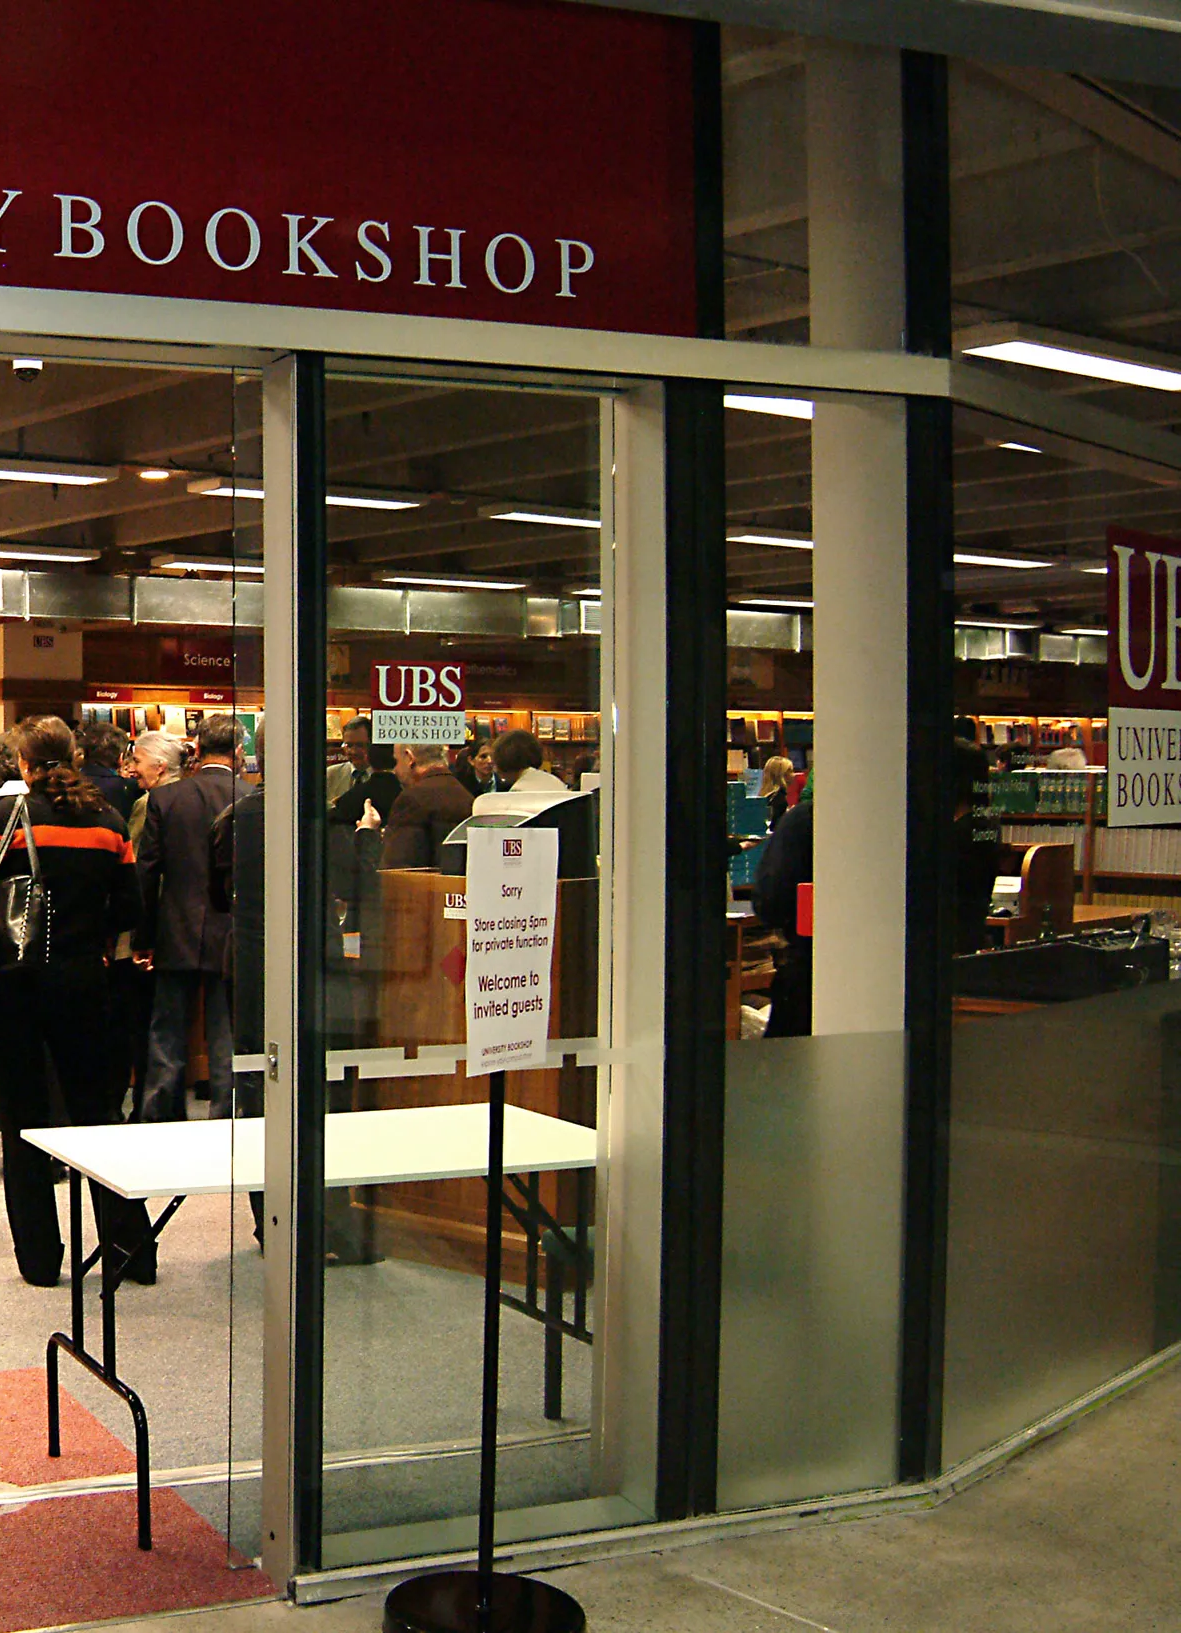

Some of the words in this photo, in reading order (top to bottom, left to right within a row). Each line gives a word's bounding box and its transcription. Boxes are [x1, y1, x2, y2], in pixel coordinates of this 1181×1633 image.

[53, 193, 596, 299] BOOKSHOP
[34, 637, 54, 648] UBS
[183, 652, 232, 668] Science
[95, 690, 118, 699] Biology
[375, 665, 462, 708] UBS
[203, 692, 225, 701] Biology
[378, 714, 461, 727] UNIVERSITY
[378, 728, 462, 740] BOOKSHOP
[1117, 726, 1181, 761] UNIVE
[1116, 772, 1181, 807] BOOK
[503, 840, 522, 856] UBS
[501, 884, 523, 900] Sorry
[474, 918, 496, 932] Store
[497, 915, 527, 932] closing
[529, 914, 548, 931] 5pm
[472, 939, 484, 953] for
[485, 937, 514, 955] private
[515, 934, 549, 949] function
[478, 974, 527, 992] Welcome
[529, 970, 540, 986] to
[474, 998, 509, 1020] invited
[511, 994, 543, 1018] guests
